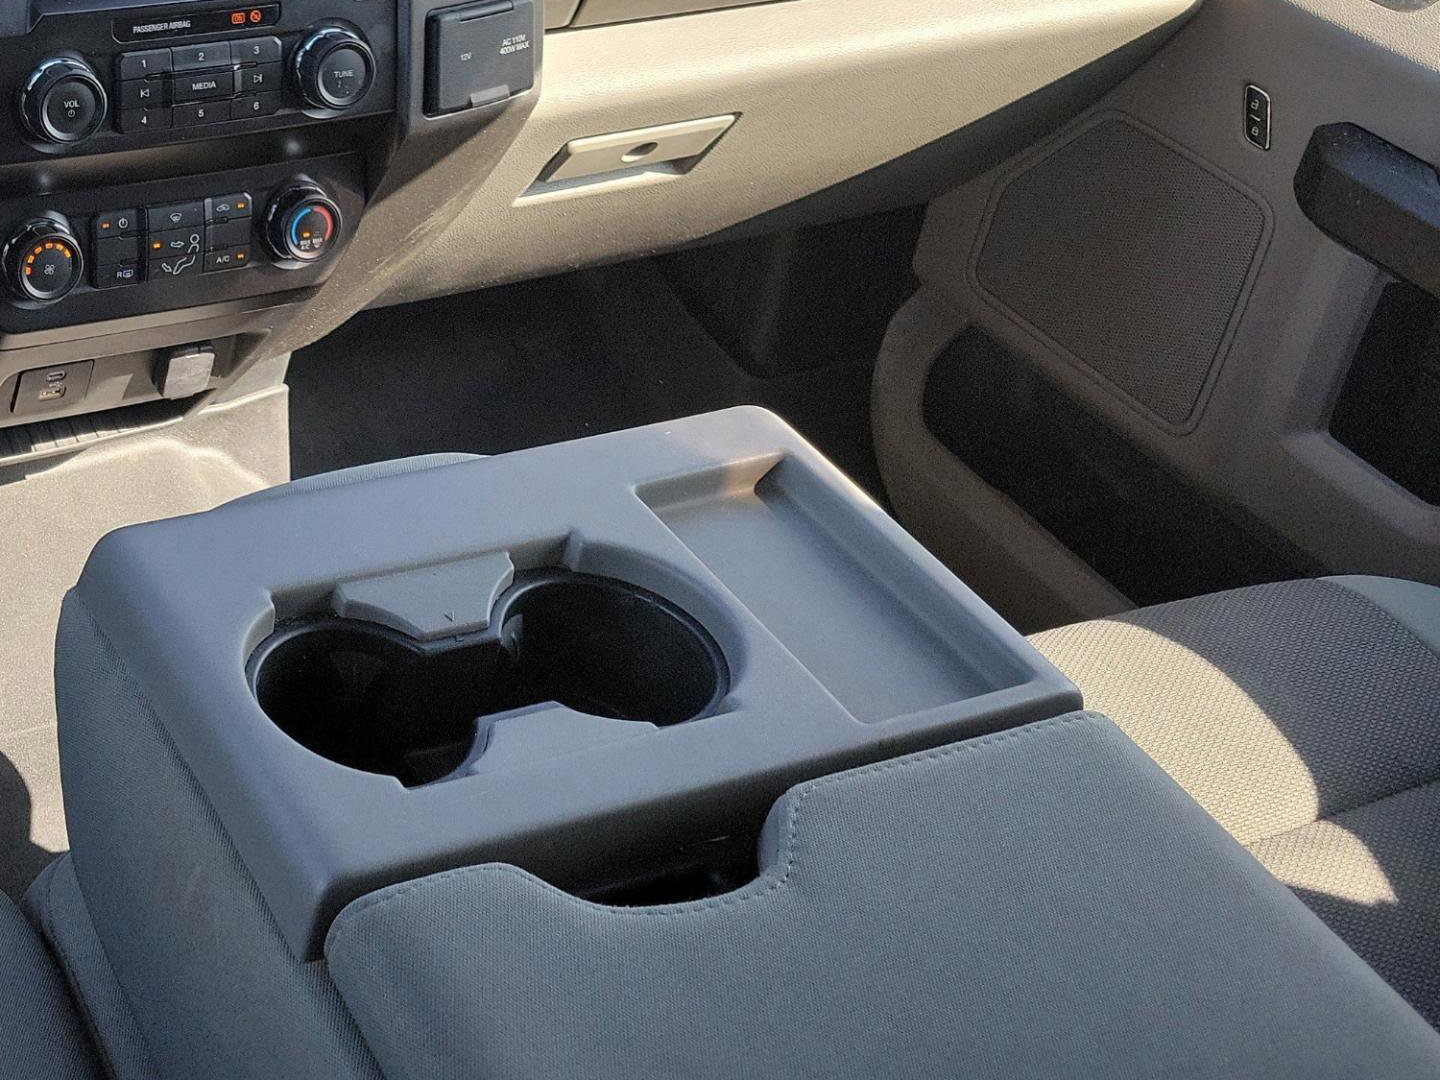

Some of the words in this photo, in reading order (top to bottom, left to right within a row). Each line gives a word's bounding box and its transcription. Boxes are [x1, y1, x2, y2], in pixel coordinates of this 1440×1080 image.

[334, 70, 354, 78] TUNE
[192, 80, 217, 91] MEDIA
[63, 100, 80, 109] VOL
[216, 255, 230, 264] A/C
